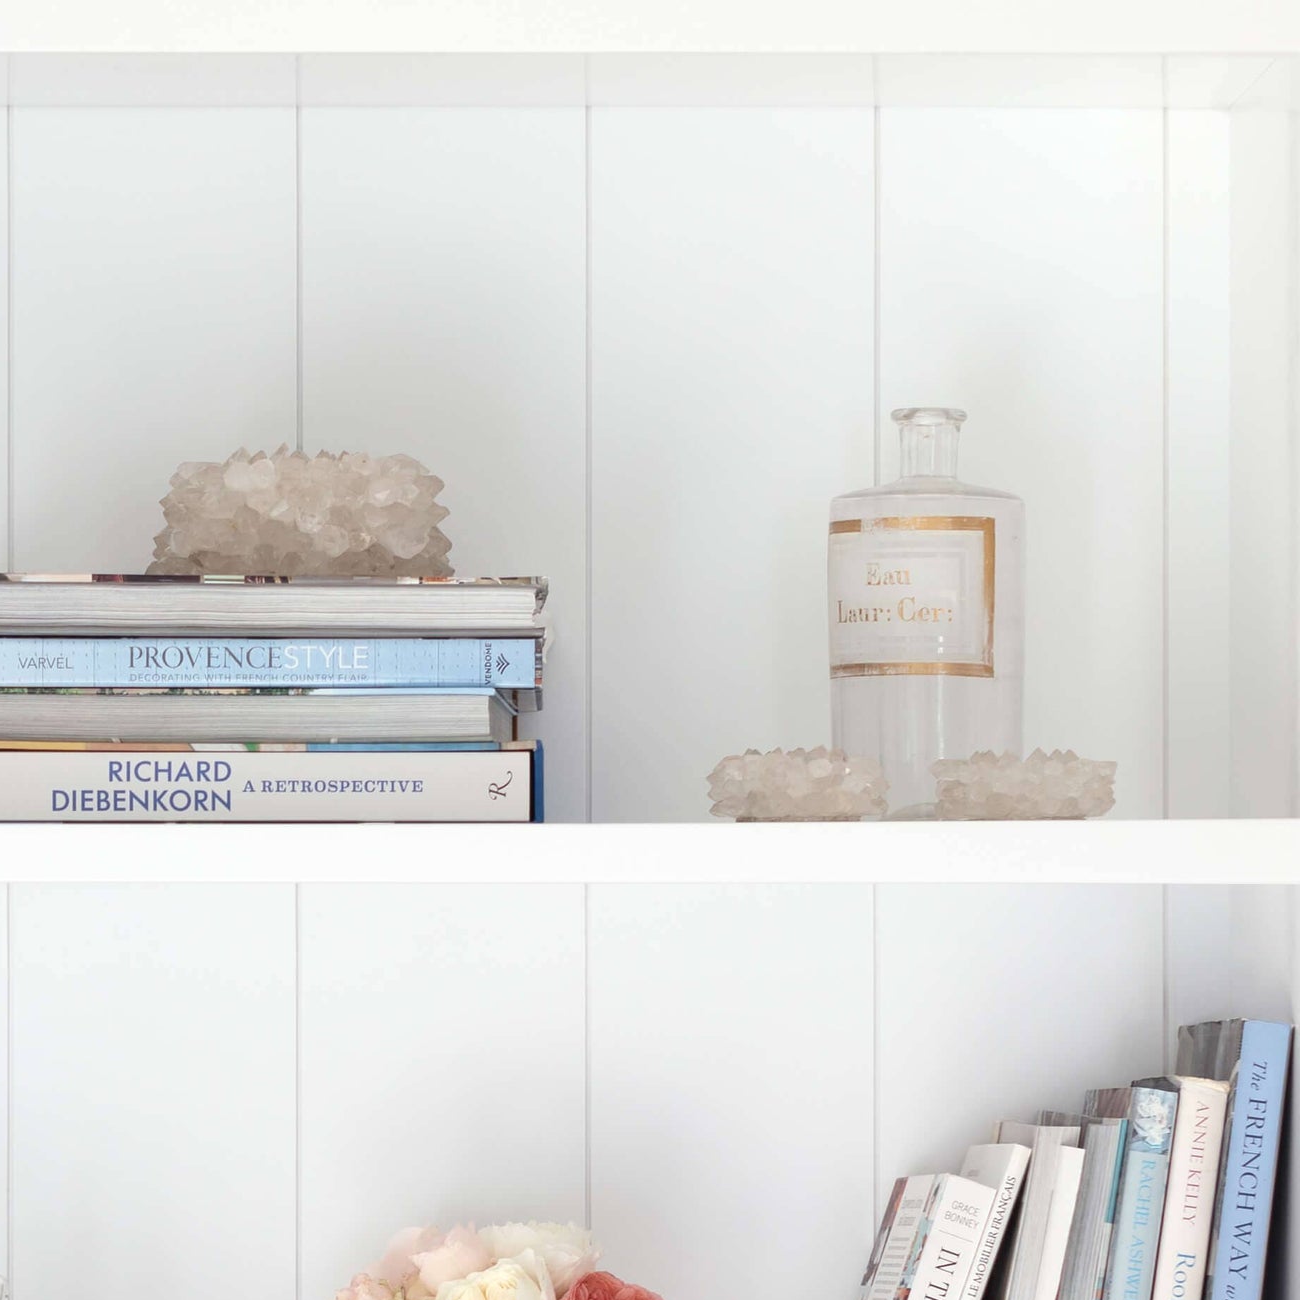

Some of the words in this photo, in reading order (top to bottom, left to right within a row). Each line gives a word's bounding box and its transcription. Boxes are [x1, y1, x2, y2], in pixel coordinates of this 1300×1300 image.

[865, 562, 911, 586] Eau
[897, 596, 953, 623] Cer:
[18, 656, 73, 670] VARVEL
[483, 642, 492, 685] VENDOME
[130, 673, 200, 682] DECORATING
[205, 673, 231, 682] WITH
[236, 673, 278, 682] FRENCH
[283, 673, 333, 682] COUNTRY
[338, 673, 367, 682] FLAIR
[108, 760, 232, 782] RICHARD
[242, 780, 257, 793] A
[260, 780, 424, 793] RETROSPECTIVE
[488, 770, 513, 801] R
[51, 790, 232, 812] DIEBENKORN
[1251, 1061, 1268, 1091] The
[1189, 1100, 1210, 1164] ANNIE
[1236, 1097, 1267, 1211] FRENCH
[991, 1175, 1017, 1229] FRANÇAIS
[1133, 1159, 1156, 1229] RACHEL
[1182, 1169, 1203, 1225] KELLY
[944, 1210, 980, 1230] BONNEY
[951, 1200, 981, 1217] GRACE
[935, 1247, 962, 1275] IN
[973, 1230, 997, 1283] MOBILIER
[1228, 1221, 1252, 1280] WAY
[967, 1283, 980, 1298] LE
